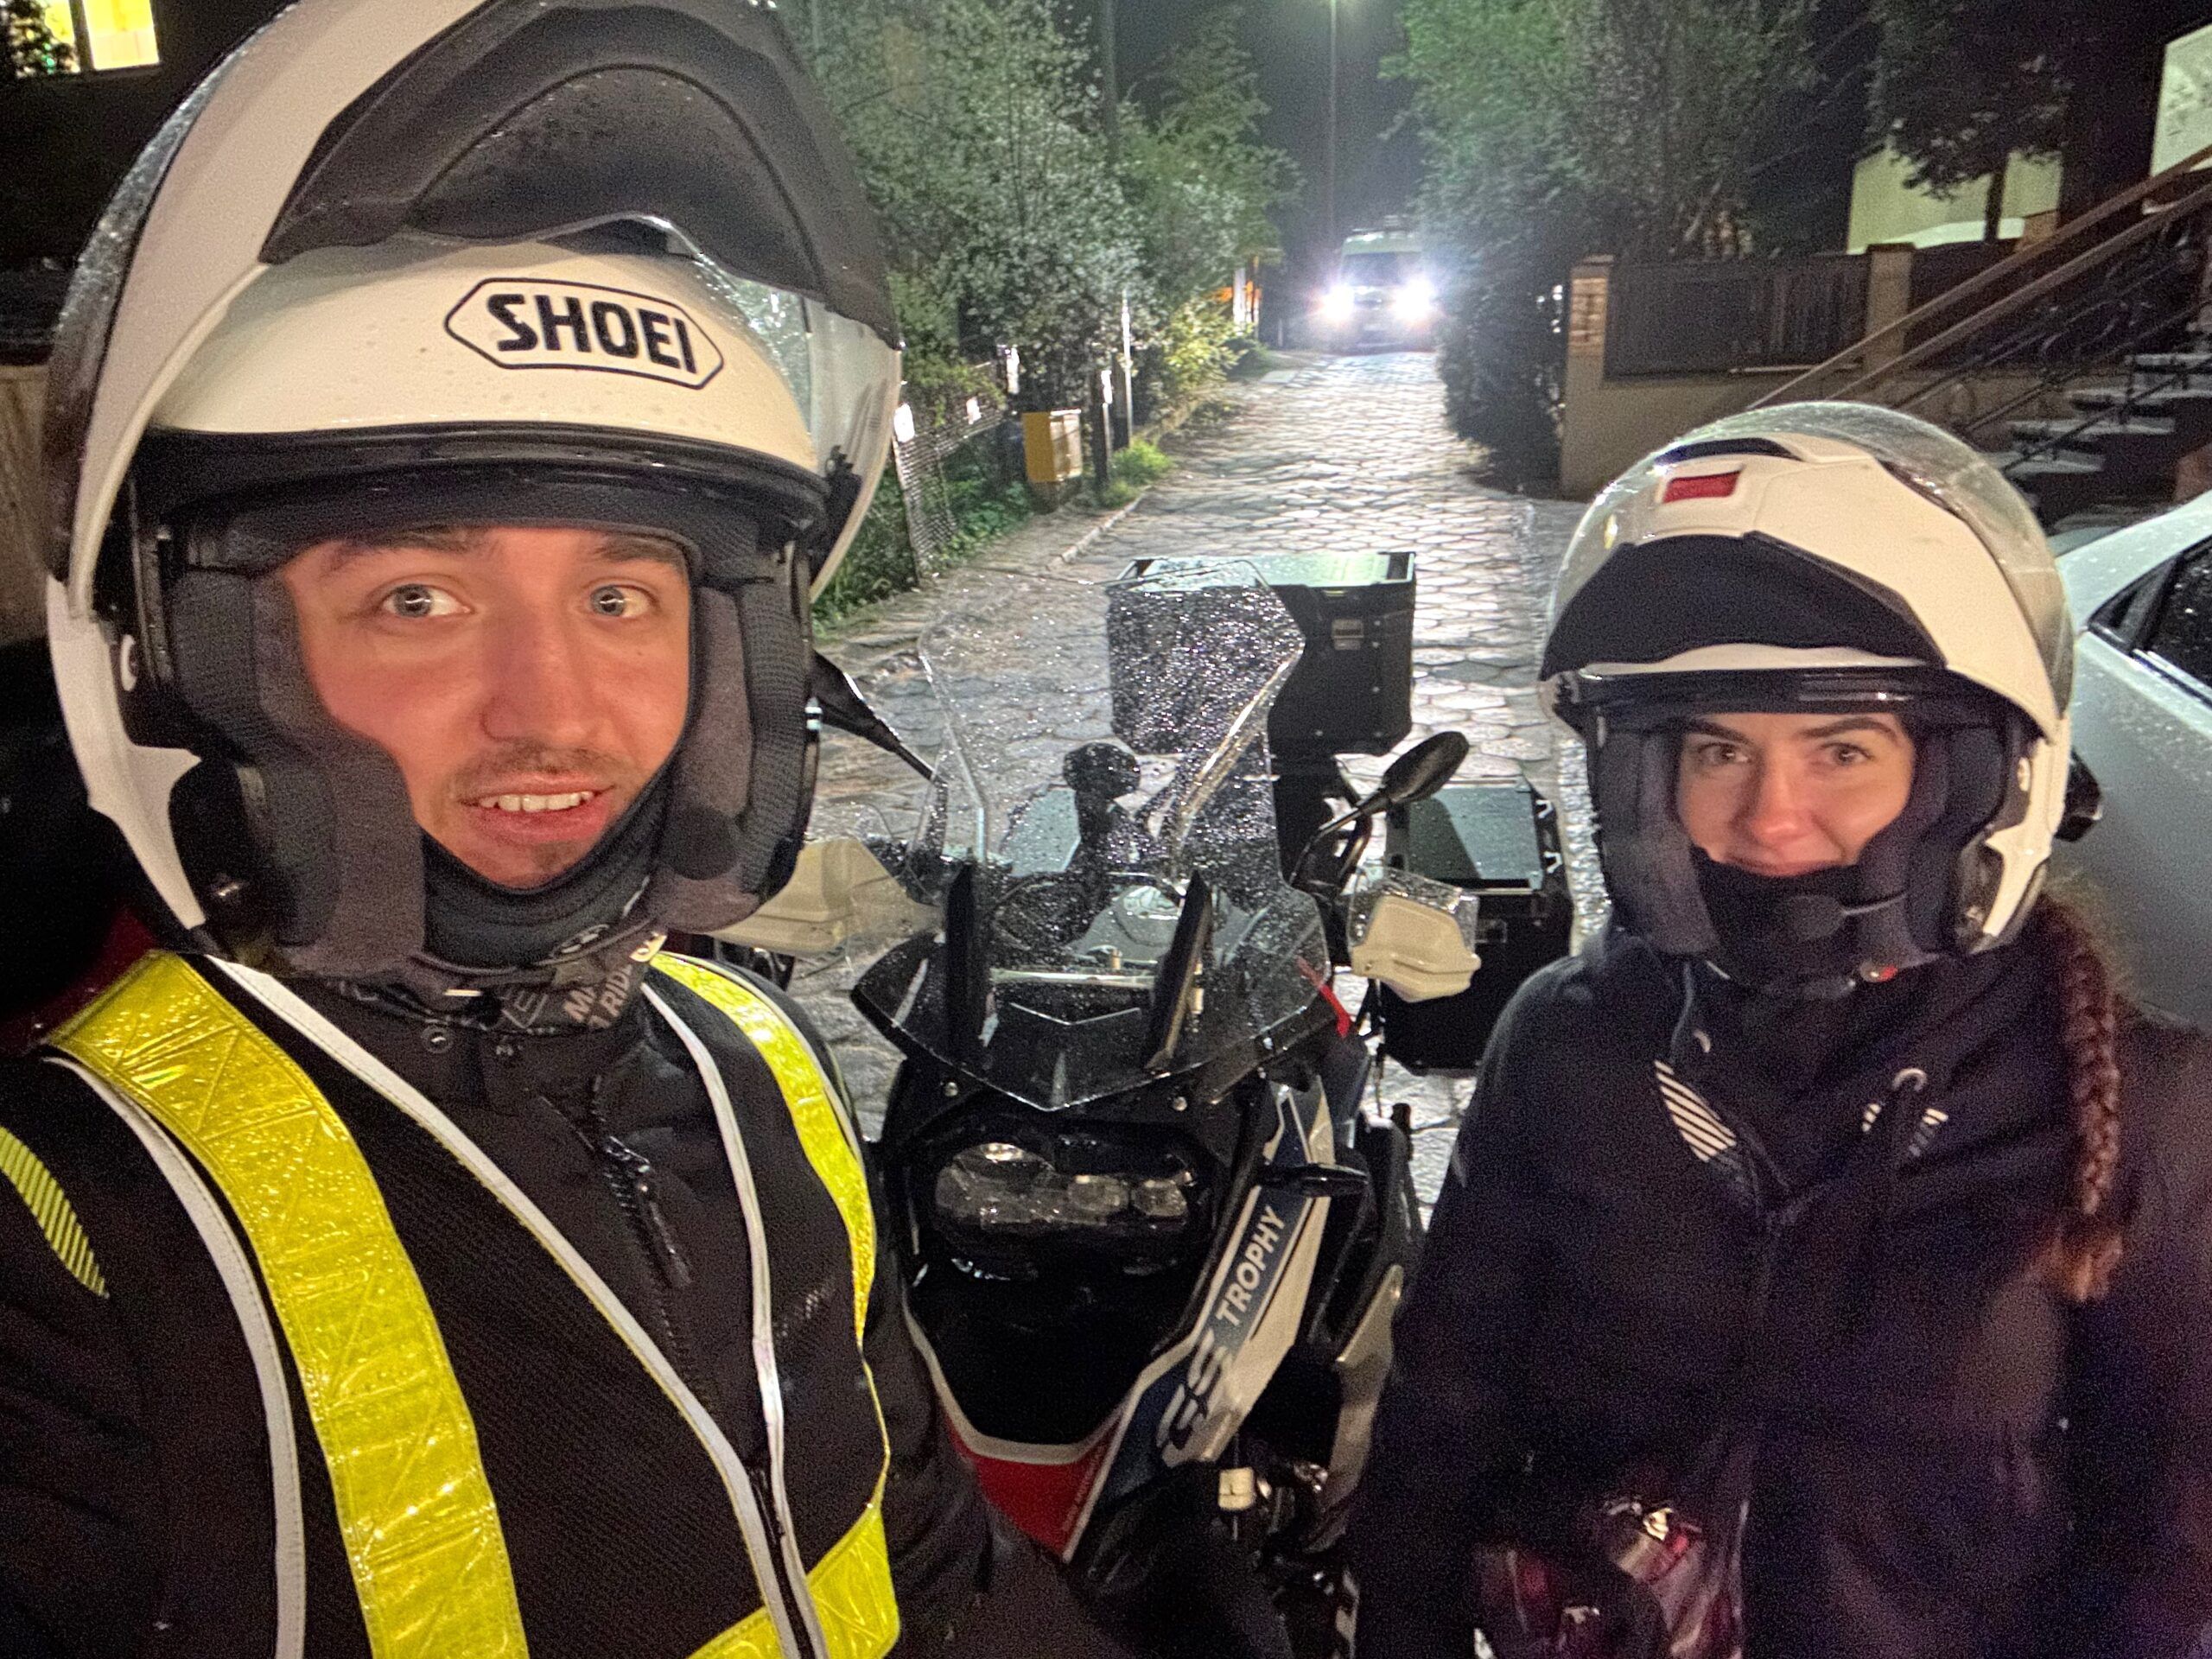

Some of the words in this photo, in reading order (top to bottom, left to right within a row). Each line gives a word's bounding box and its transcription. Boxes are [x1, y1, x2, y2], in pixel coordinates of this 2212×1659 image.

[486, 294, 696, 374] SHOEI
[1215, 1205, 1286, 1326] TROPHY
[1155, 1327, 1233, 1452] GS
